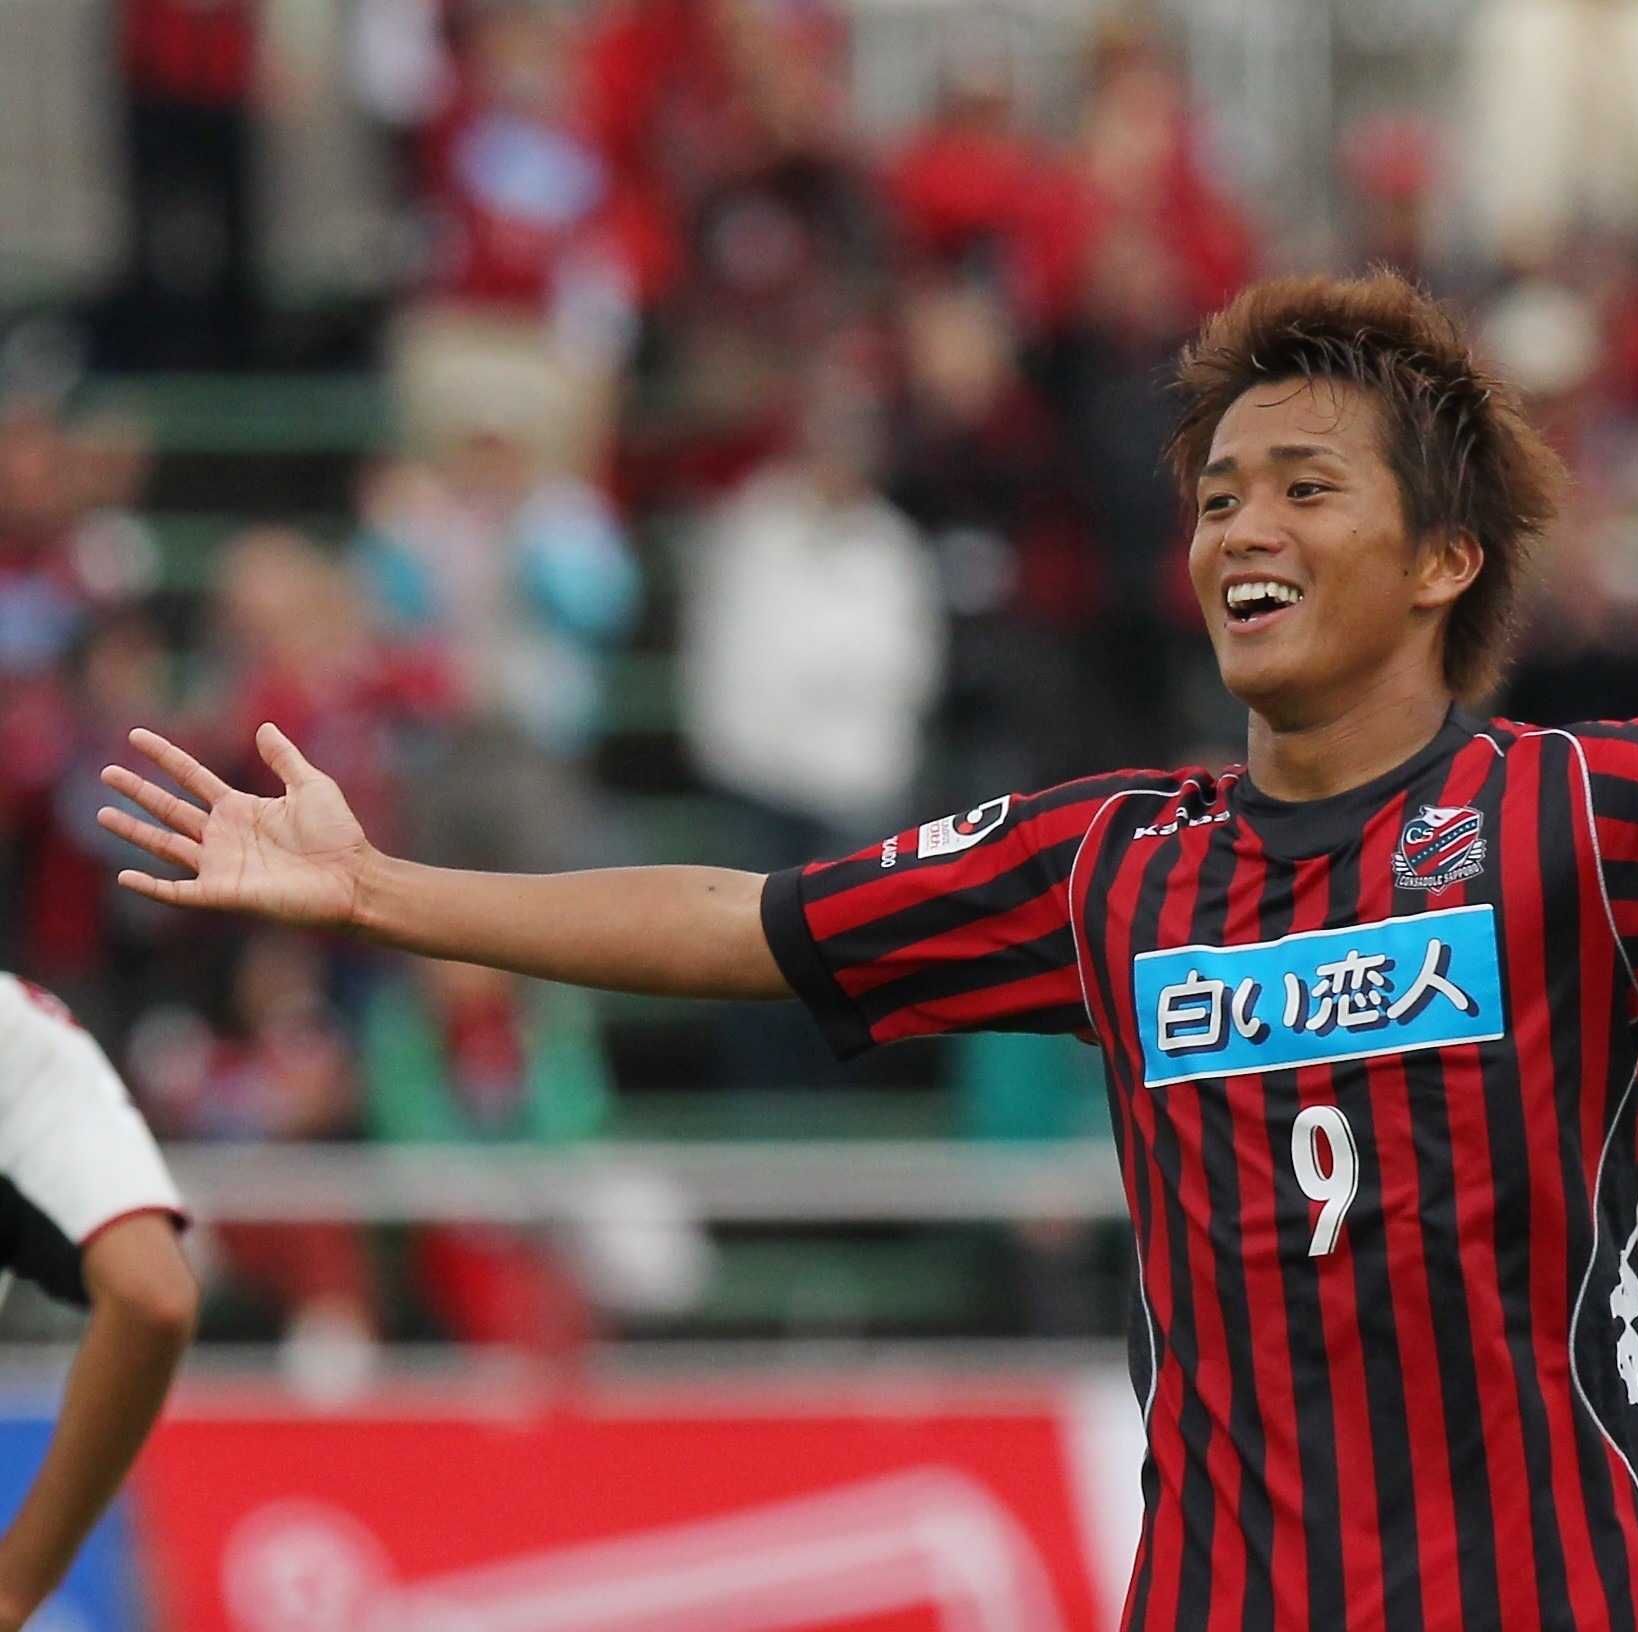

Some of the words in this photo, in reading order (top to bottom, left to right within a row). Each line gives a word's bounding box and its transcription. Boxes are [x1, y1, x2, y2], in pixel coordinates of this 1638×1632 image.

[1157, 938, 1469, 1051] 白い恋人
[1291, 1105, 1360, 1257] 9
